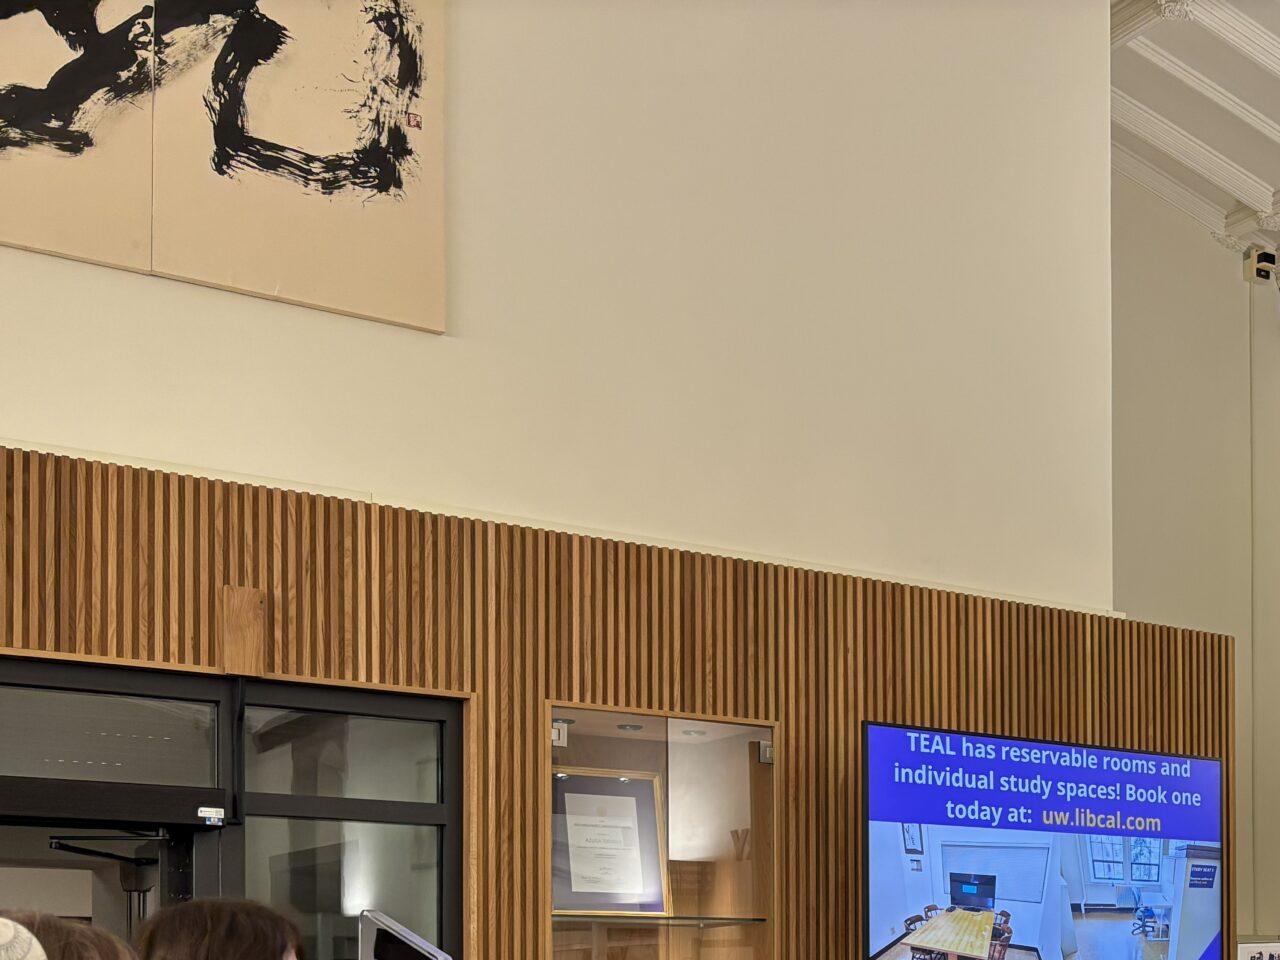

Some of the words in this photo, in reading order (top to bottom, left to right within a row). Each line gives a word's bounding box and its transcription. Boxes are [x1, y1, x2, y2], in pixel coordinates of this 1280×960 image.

[906, 732, 956, 756] TEAL
[962, 737, 996, 760] has
[1001, 742, 1097, 770] reservable
[1103, 756, 1156, 774] rooms
[1160, 760, 1191, 778] and
[893, 763, 994, 790] individual
[1000, 774, 1051, 800] study
[1056, 780, 1121, 802] spaces!
[1126, 784, 1167, 804] Book
[1171, 791, 1201, 806] one
[945, 800, 1002, 826] today
[1008, 805, 1032, 824] at:
[1042, 808, 1161, 831] uw.libcal.com
